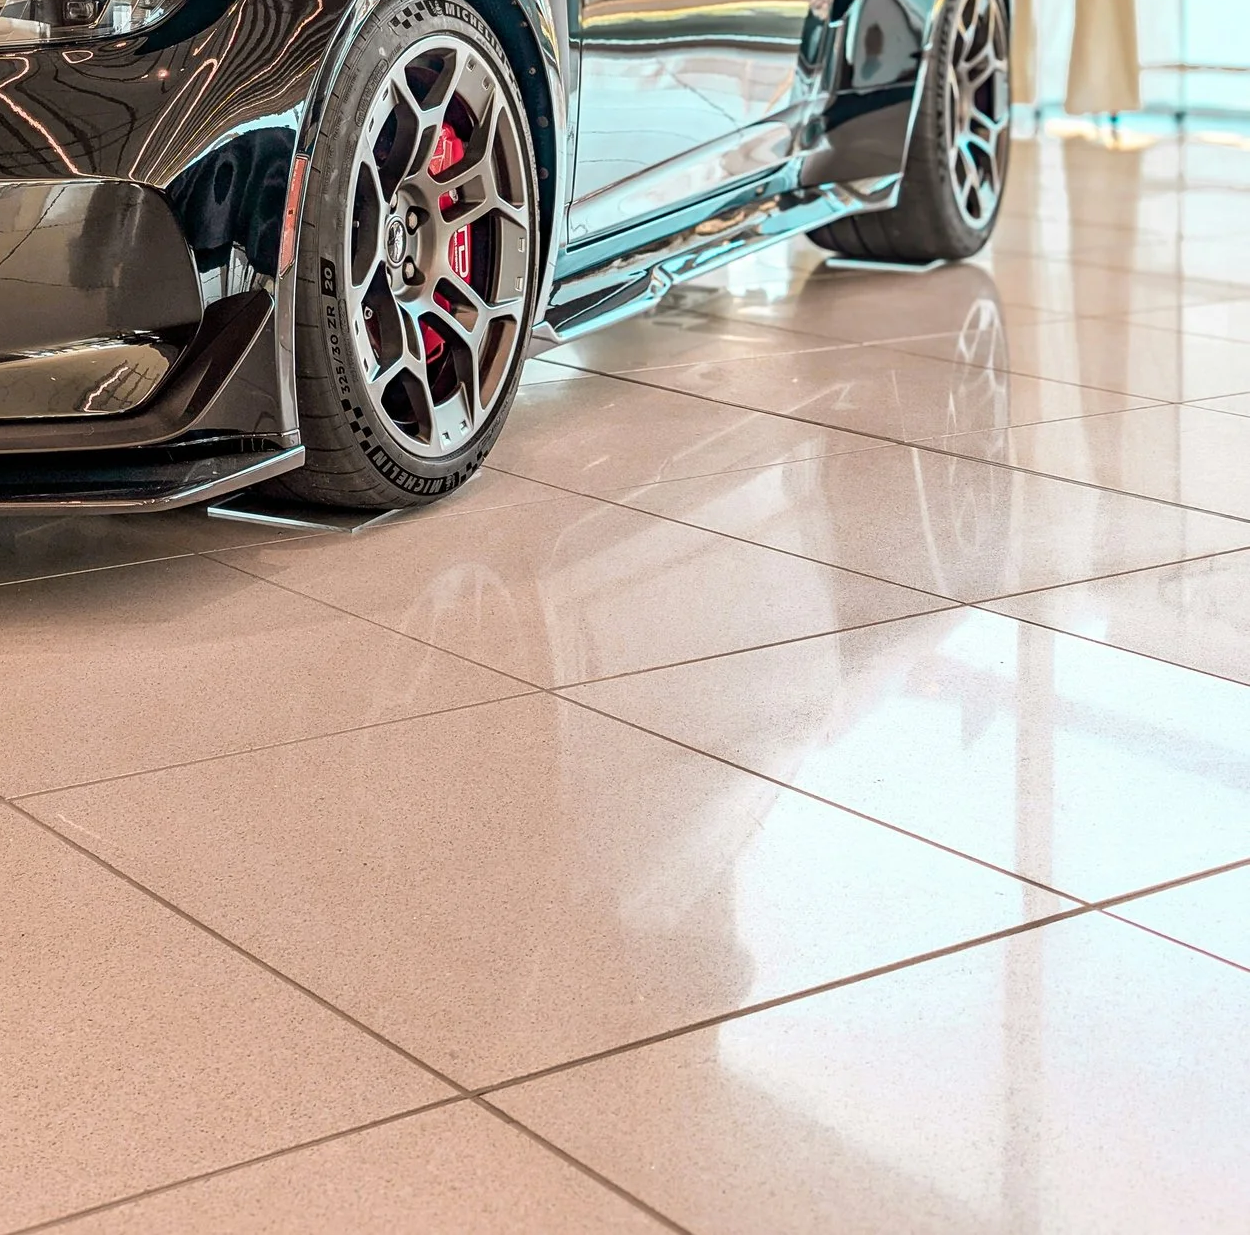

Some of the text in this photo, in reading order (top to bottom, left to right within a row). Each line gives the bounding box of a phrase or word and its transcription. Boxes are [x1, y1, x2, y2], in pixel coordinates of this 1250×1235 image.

[444, 2, 505, 60] MICHELIN
[324, 267, 334, 292] 20
[326, 305, 337, 329] ZR
[329, 334, 350, 394] 325/30
[372, 450, 444, 494] MICHELIN
